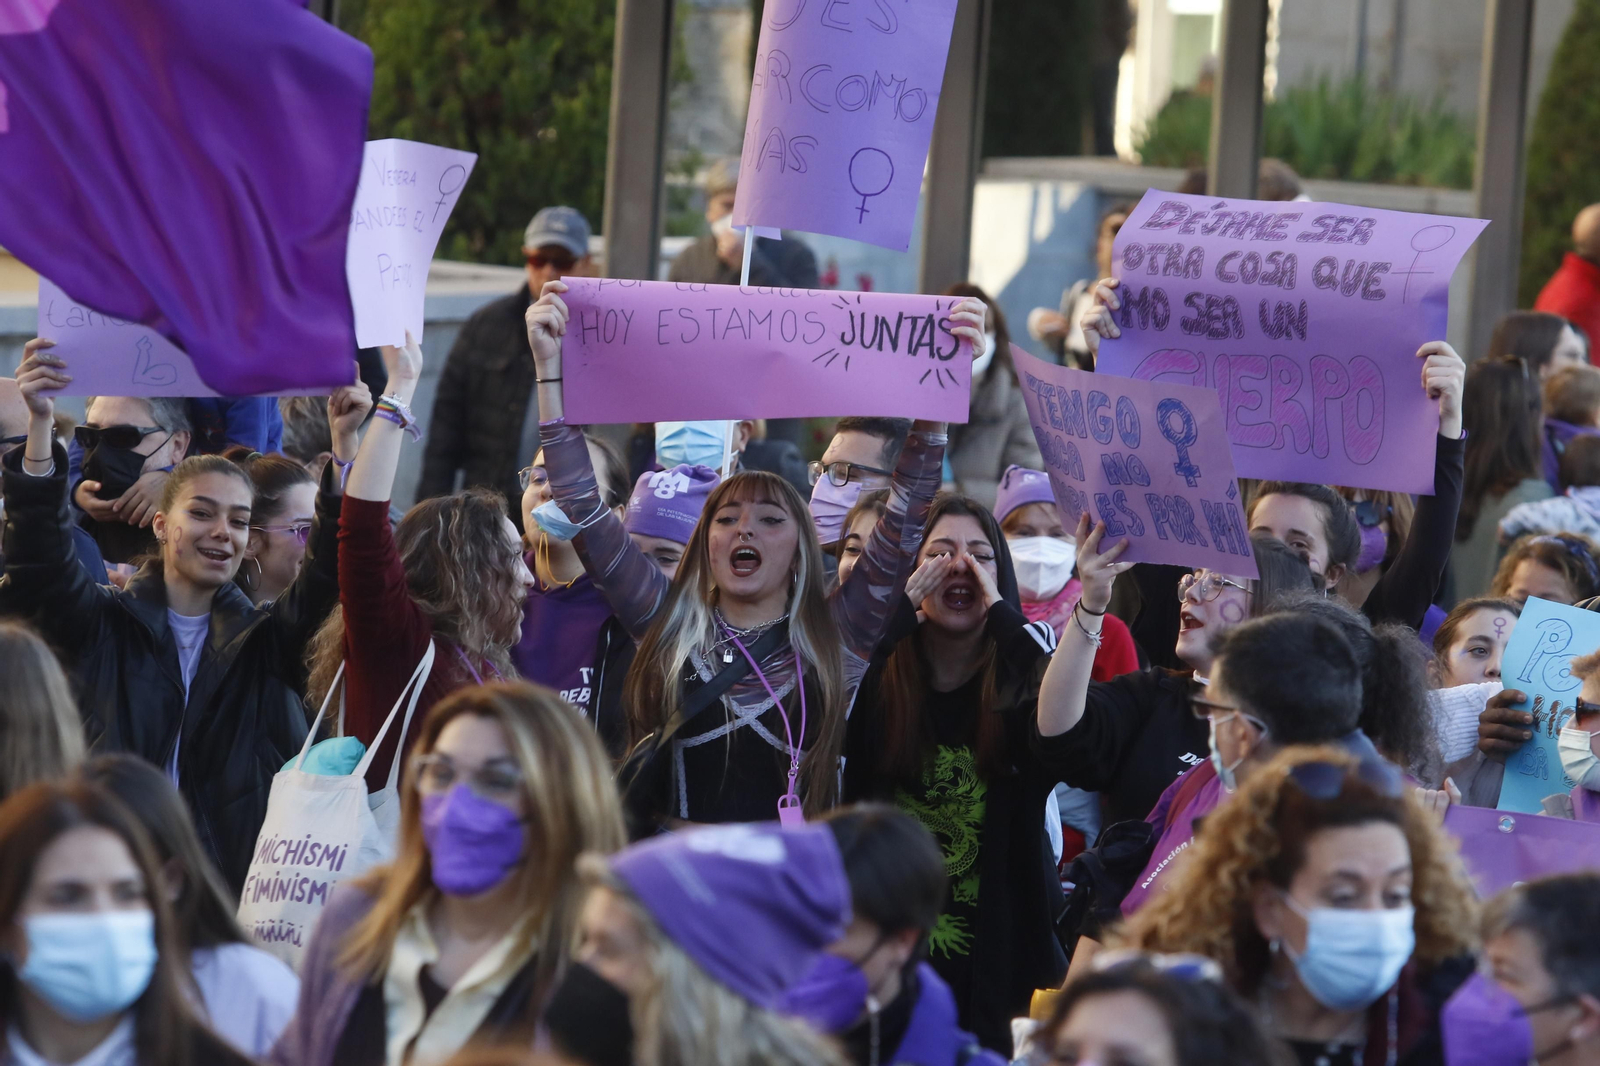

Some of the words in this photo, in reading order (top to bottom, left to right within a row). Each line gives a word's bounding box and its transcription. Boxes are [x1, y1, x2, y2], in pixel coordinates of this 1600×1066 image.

[799, 63, 928, 123] COMO
[1139, 200, 1303, 241] DÉJAME
[1296, 214, 1377, 245] SER
[1122, 242, 1205, 279] OTRA
[1215, 250, 1298, 290] COSA
[1312, 255, 1393, 301] QUE
[580, 308, 635, 346] HOY
[657, 308, 826, 346] ESTAMOS
[840, 310, 961, 362] JUNTAS
[1120, 285, 1171, 331] NO
[1179, 291, 1246, 340] SER
[1258, 298, 1309, 341] UN
[1025, 371, 1141, 449] TENGO
[1101, 451, 1151, 487] NO
[1145, 493, 1209, 548] POR
[1141, 840, 1189, 889] Asociación
